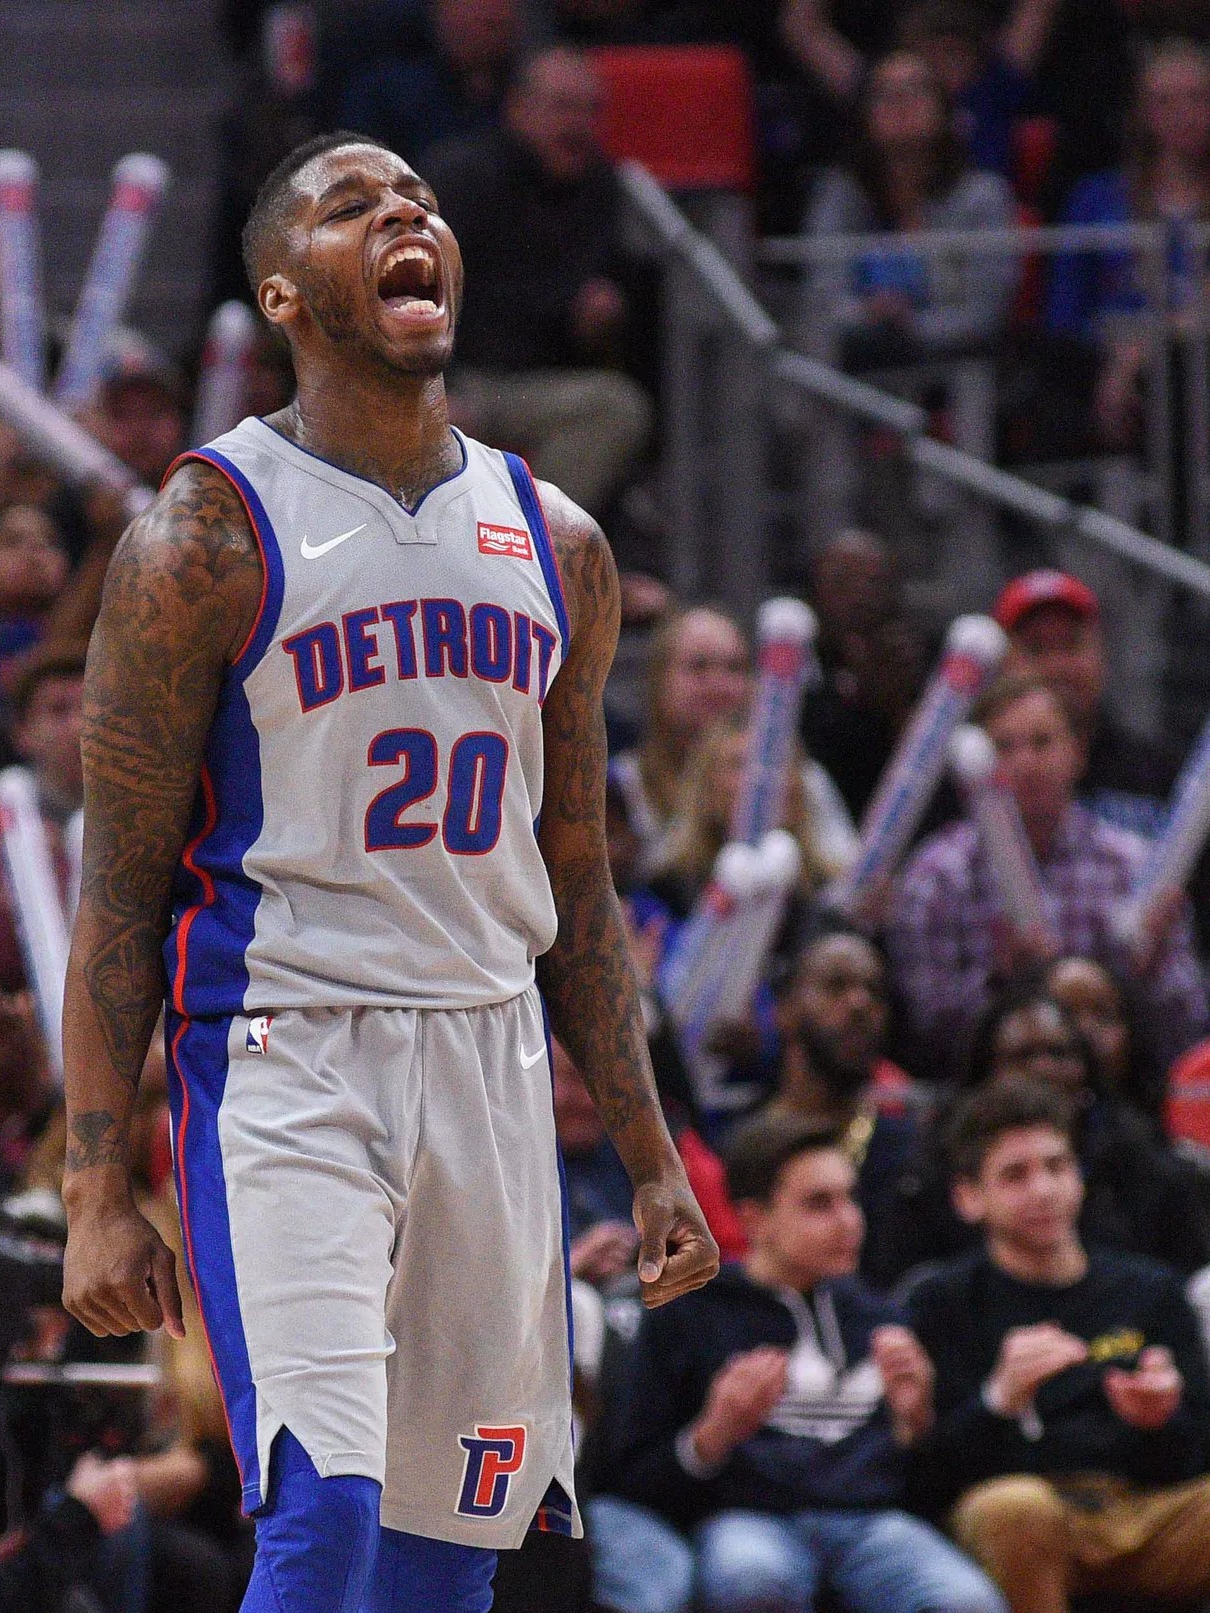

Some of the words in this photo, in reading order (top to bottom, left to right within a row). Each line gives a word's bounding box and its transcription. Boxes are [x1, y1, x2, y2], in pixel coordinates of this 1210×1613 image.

[480, 527, 526, 545] Flagstar
[282, 598, 557, 714] DETROIT
[364, 728, 509, 855] 20
